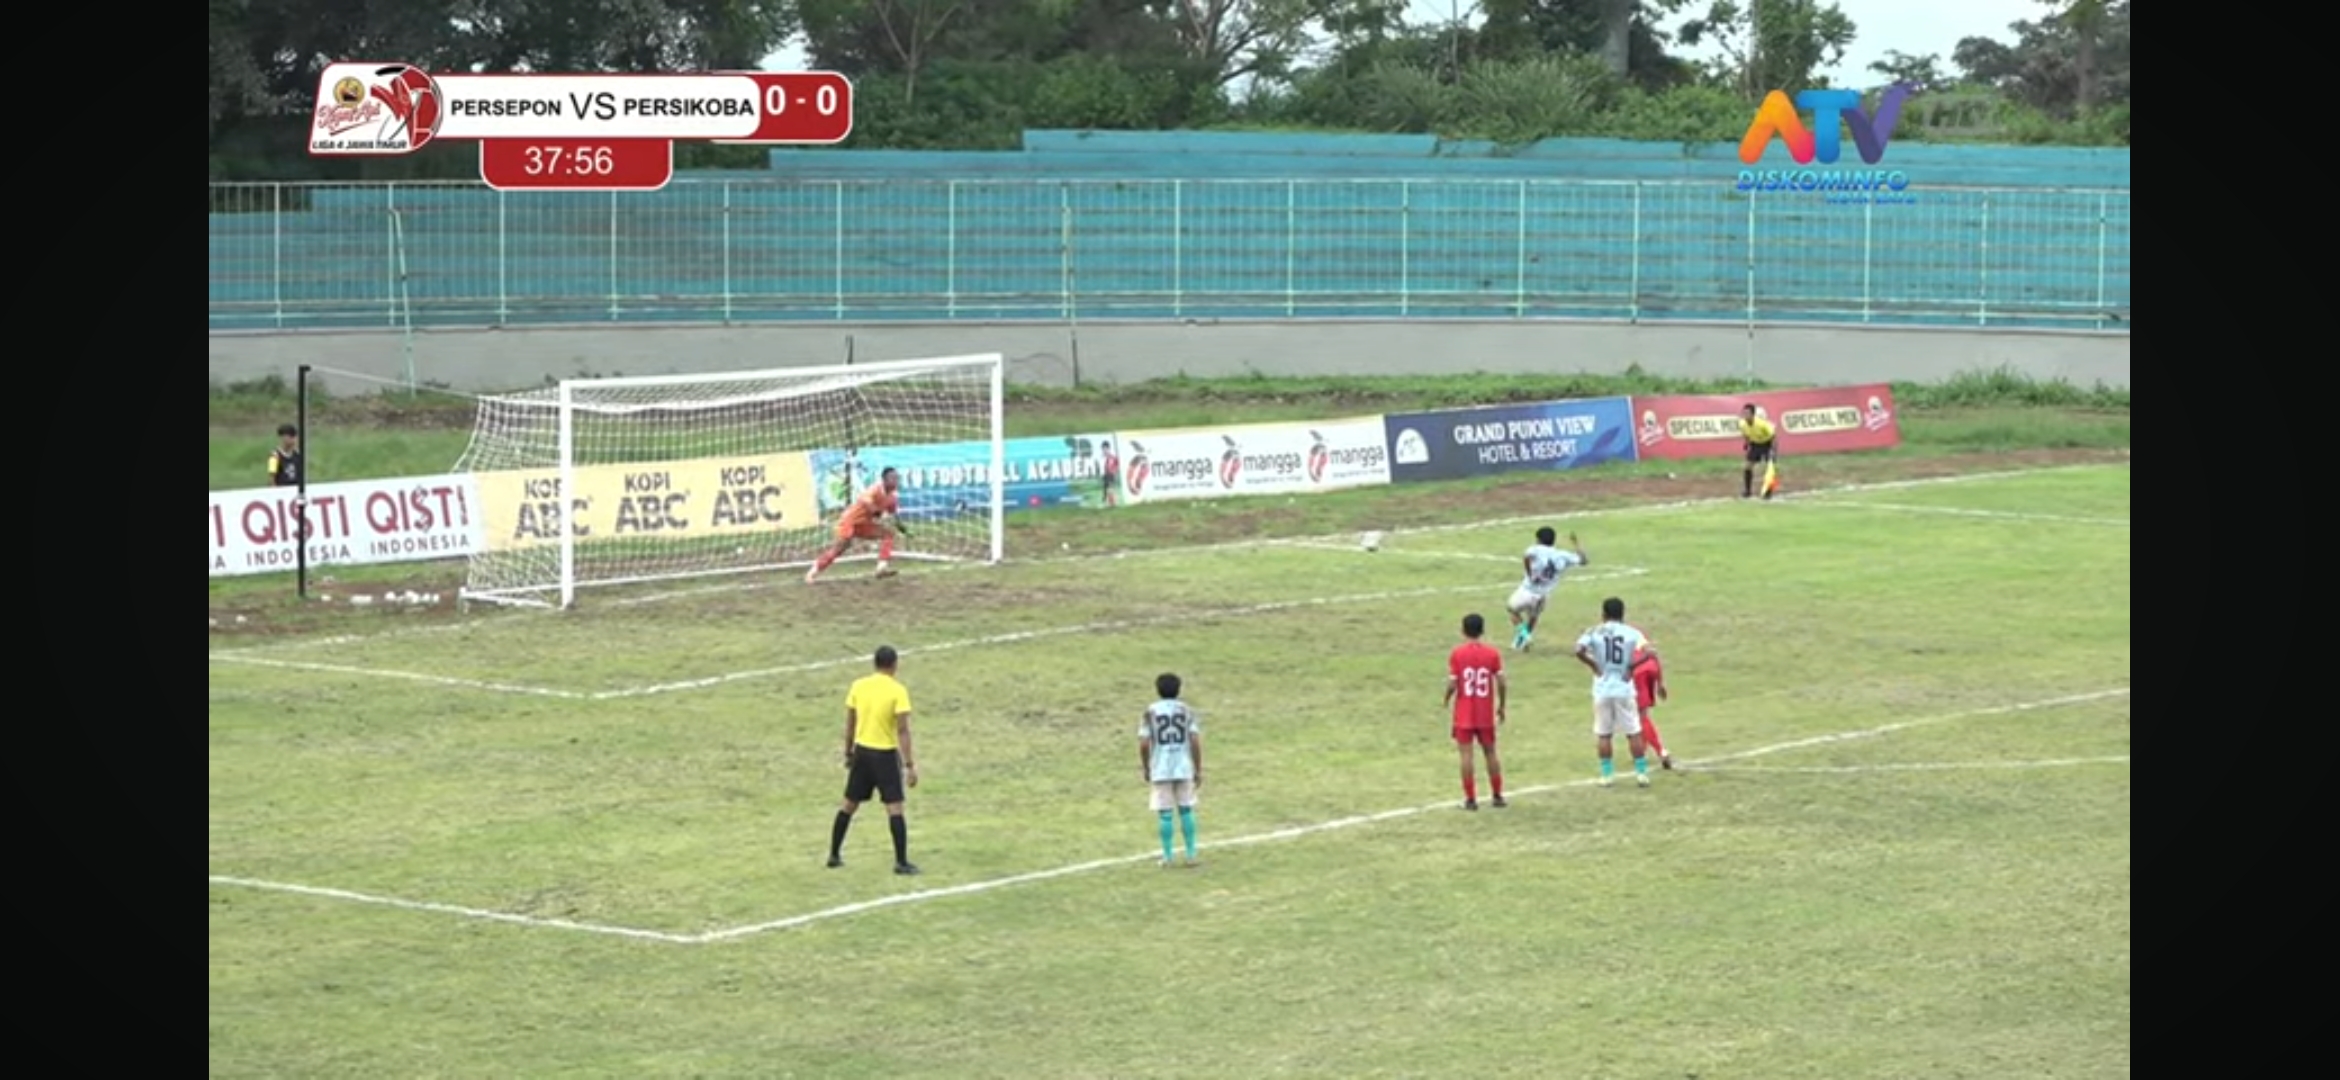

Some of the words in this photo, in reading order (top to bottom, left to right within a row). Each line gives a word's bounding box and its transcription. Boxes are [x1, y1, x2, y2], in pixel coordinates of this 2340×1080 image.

[1454, 423, 1505, 444] GRAND
[1555, 415, 1595, 436] VIEW
[1670, 417, 1720, 436] SPECIAL
[1783, 409, 1836, 431] SPECIAL
[1329, 445, 1385, 468] mangga
[1478, 443, 1519, 464] HOTEL
[1520, 441, 1531, 461] &
[1532, 439, 1577, 459] RESORT
[1151, 457, 1214, 480] mangga
[1243, 452, 1302, 475] mangga
[624, 471, 671, 493] KOPI
[720, 464, 766, 487] KOPI
[523, 477, 563, 499] KOP
[365, 485, 469, 534] QISTI
[614, 492, 690, 533] ABC
[710, 485, 784, 527] ABC
[241, 495, 349, 546] QISTI
[246, 544, 351, 567] INDOESIA
[370, 534, 470, 556] INDONESIA
[1603, 635, 1624, 665] 16
[1156, 714, 1186, 746] 25
